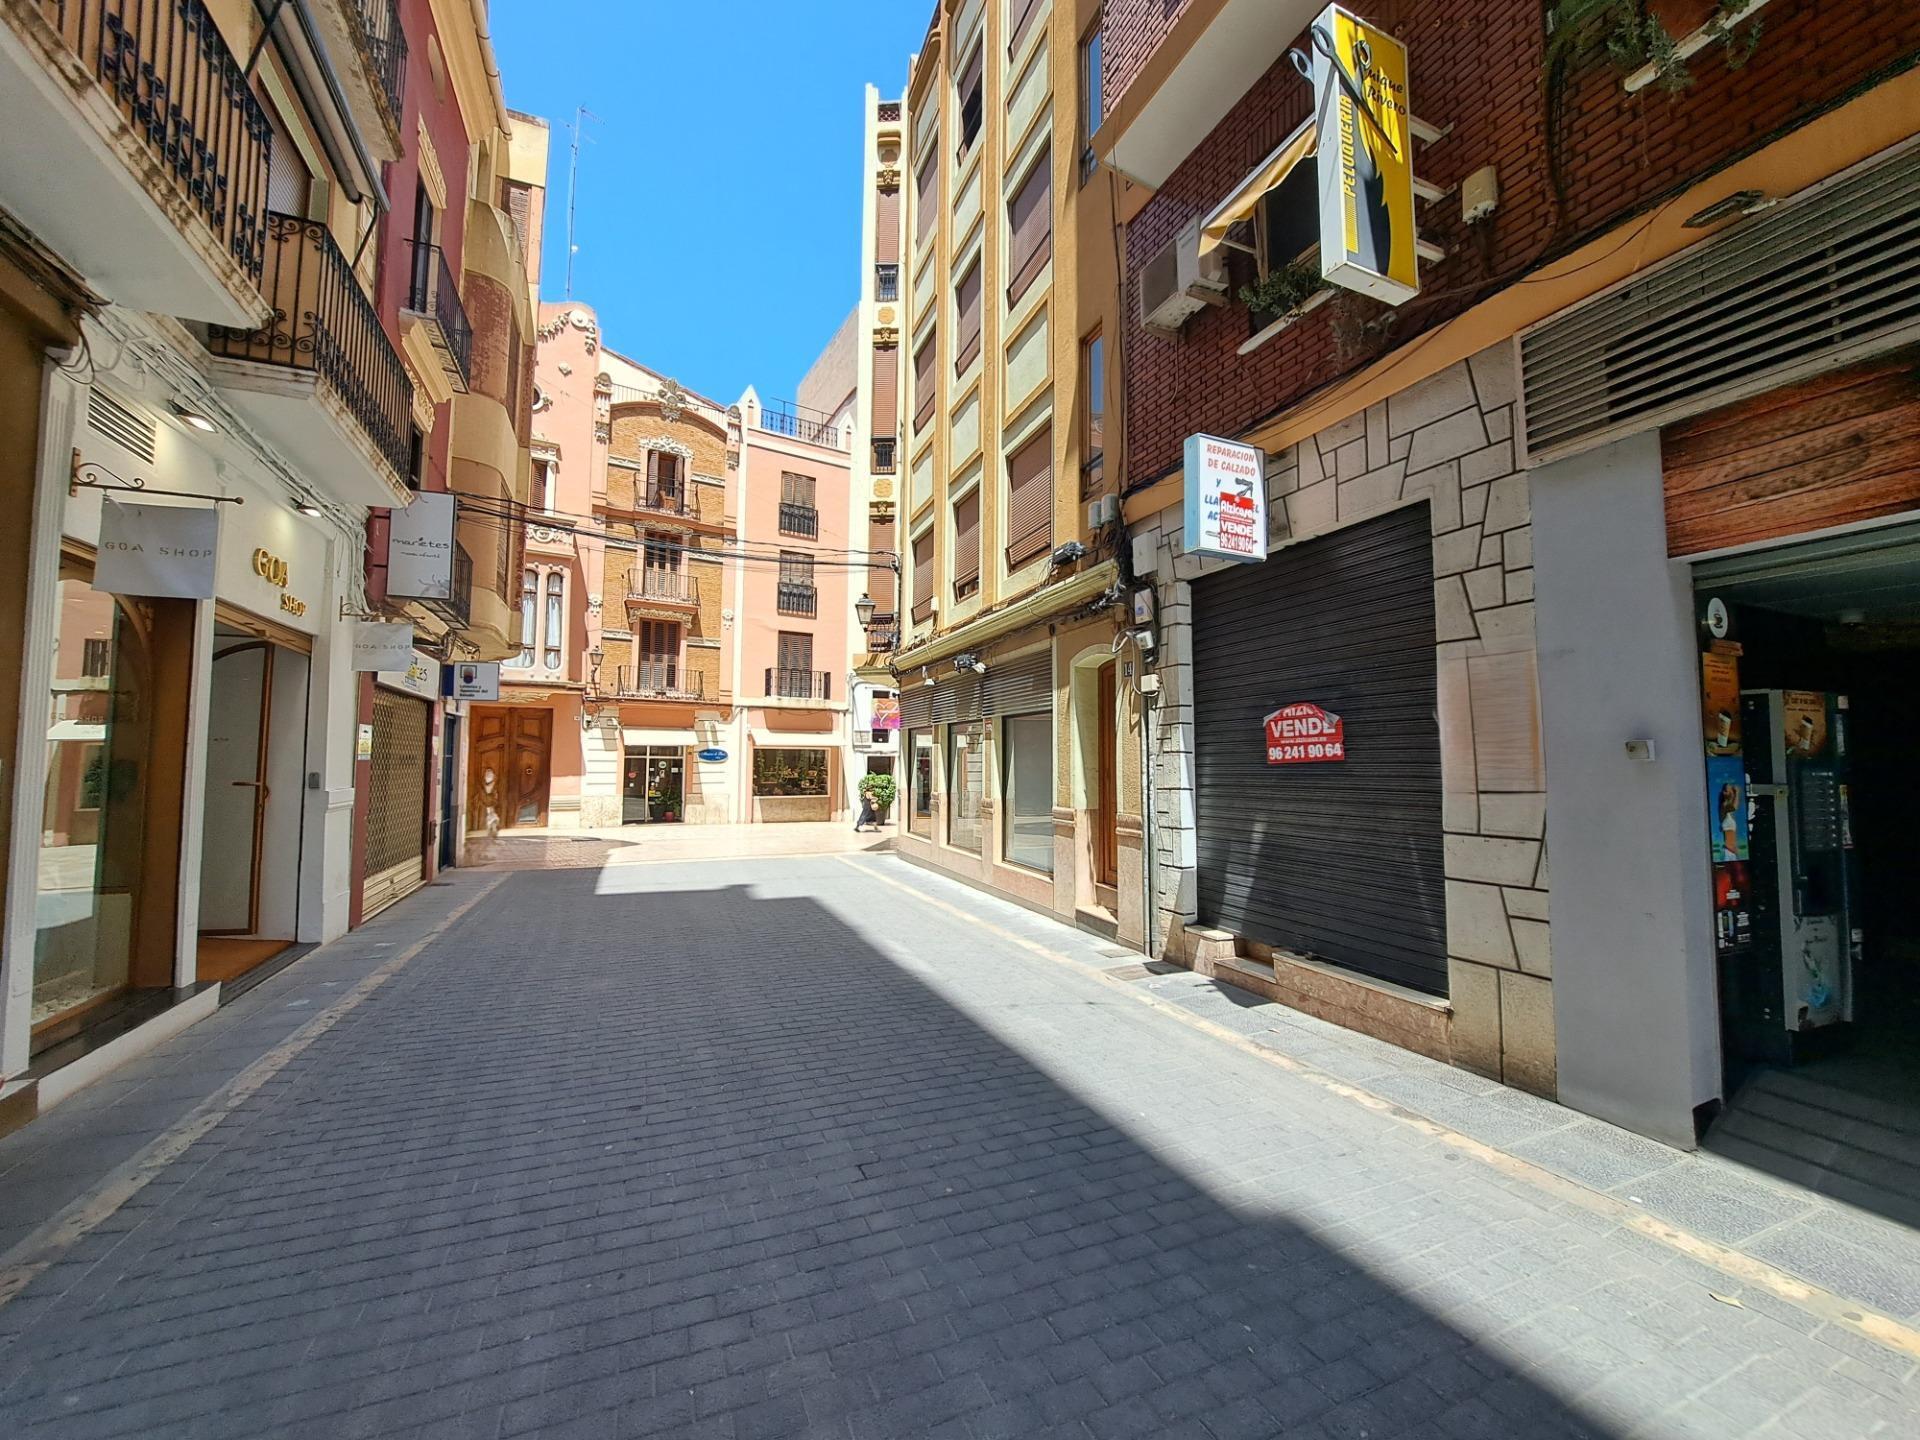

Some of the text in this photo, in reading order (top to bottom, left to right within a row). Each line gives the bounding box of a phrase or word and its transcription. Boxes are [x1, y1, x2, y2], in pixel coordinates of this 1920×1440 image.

[1368, 85, 1406, 116] Rivero
[1341, 95, 1357, 197] PELUQUERIA
[1207, 444, 1255, 462] REPARACION
[1208, 458, 1256, 476] DE CALZADO
[1205, 494, 1219, 505] LLA
[1208, 511, 1220, 521] AC
[1220, 520, 1253, 536] VENDE
[104, 542, 212, 557] GOA SHOP
[252, 548, 289, 588] GOA
[1124, 662, 1132, 676] 14
[1270, 717, 1336, 738] VENDE
[1269, 742, 1342, 760] 96 241 90 64
